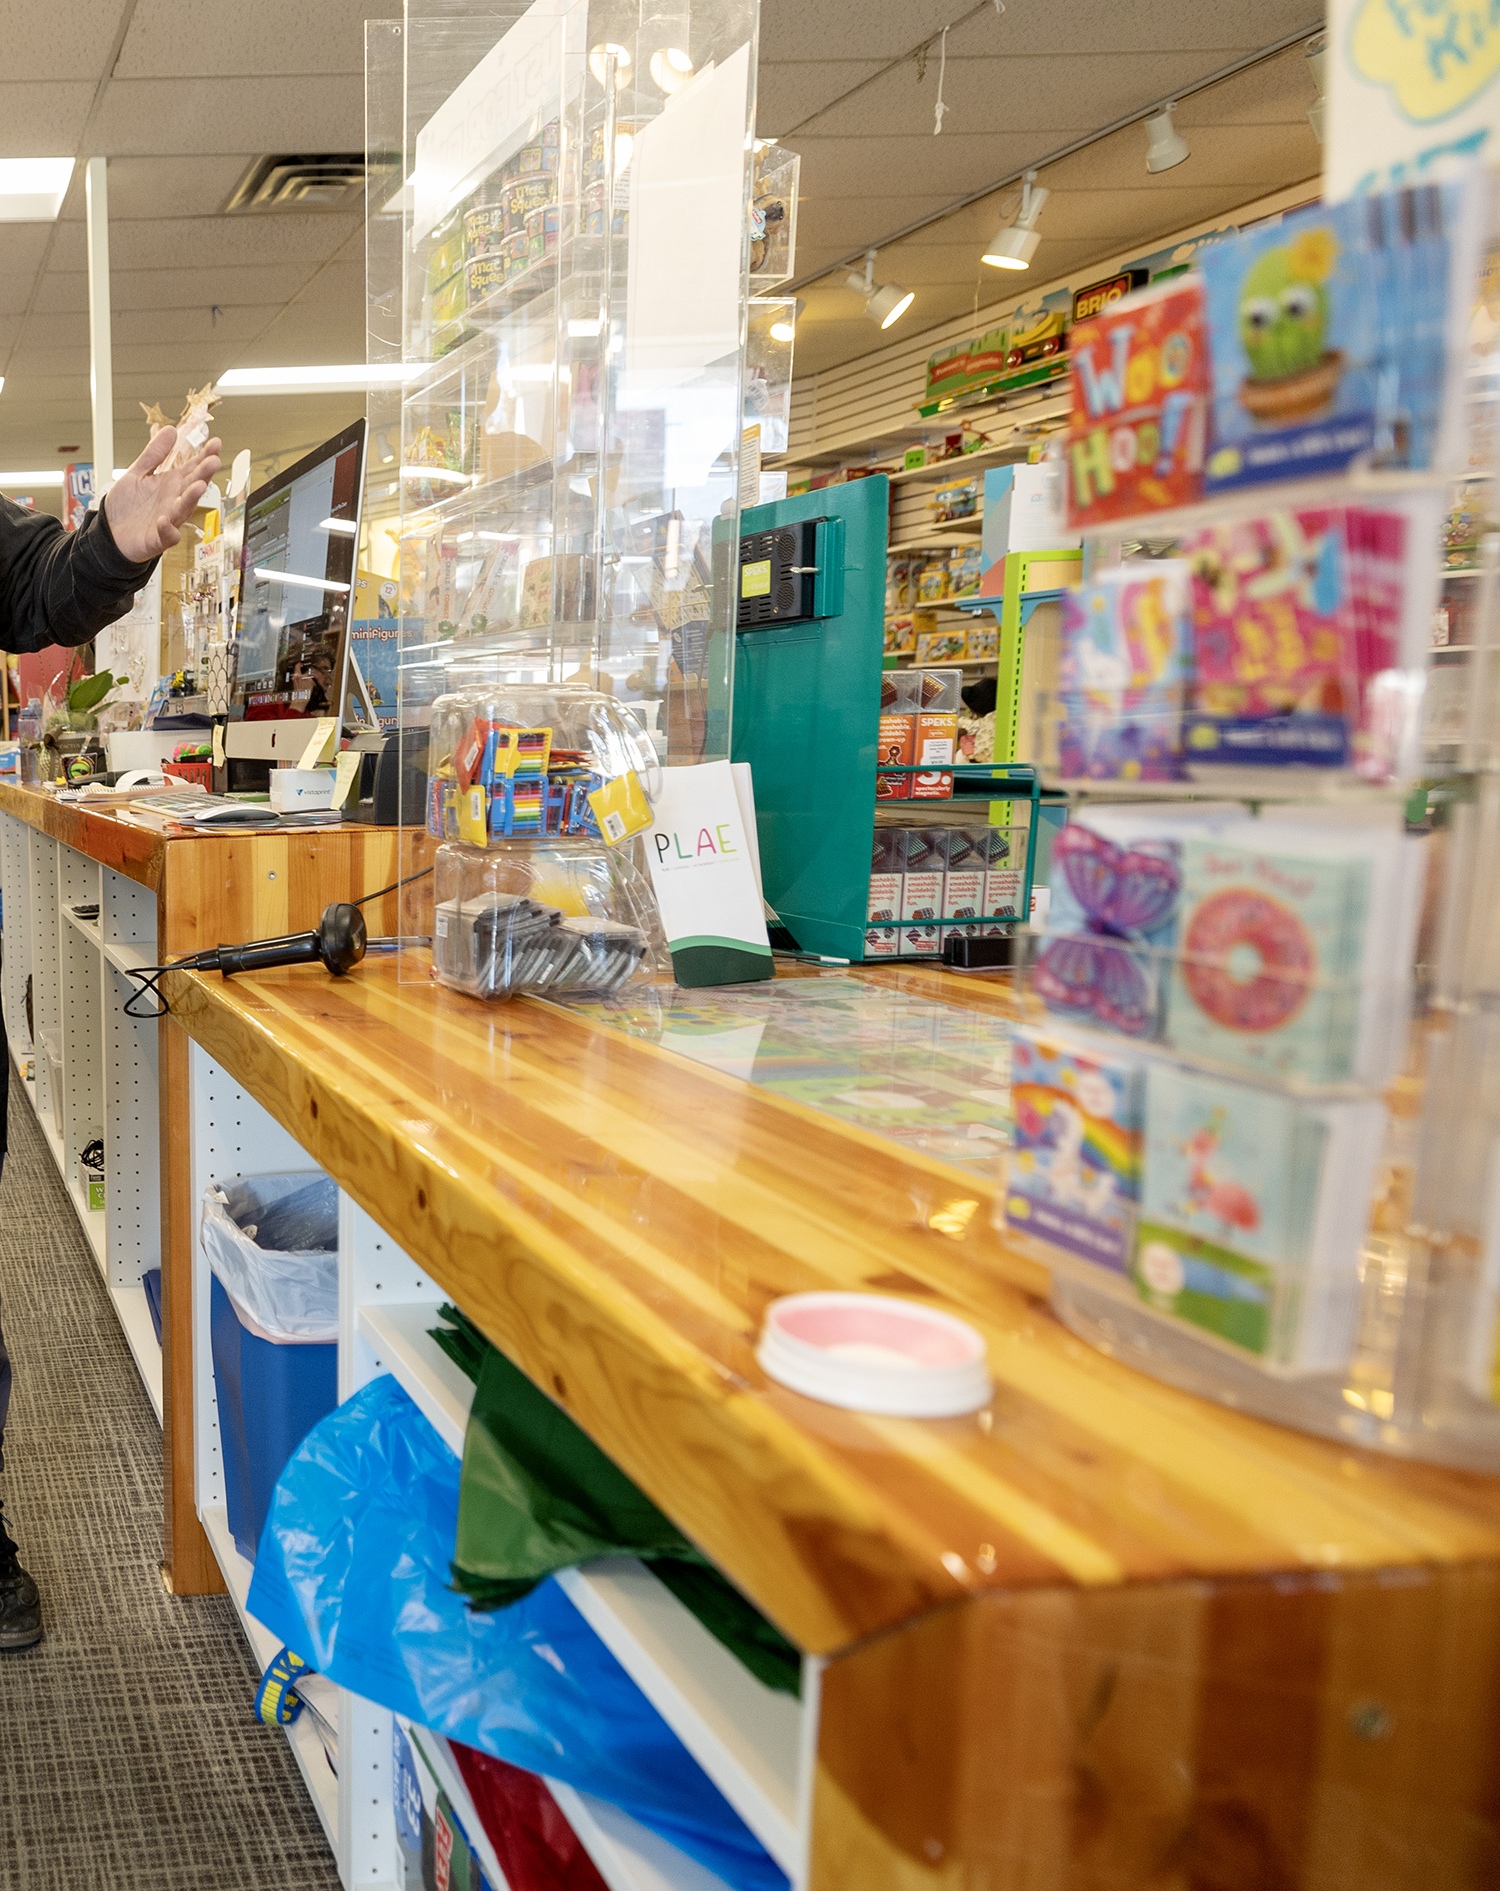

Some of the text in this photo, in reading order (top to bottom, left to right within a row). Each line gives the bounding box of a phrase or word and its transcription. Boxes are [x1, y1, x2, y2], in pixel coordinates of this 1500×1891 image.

[1077, 287, 1122, 318] BRIO
[920, 717, 956, 727] SPEKS.
[304, 789, 331, 797] vistaprint
[654, 824, 737, 864] PLAE
[406, 1776, 422, 1837] 33
